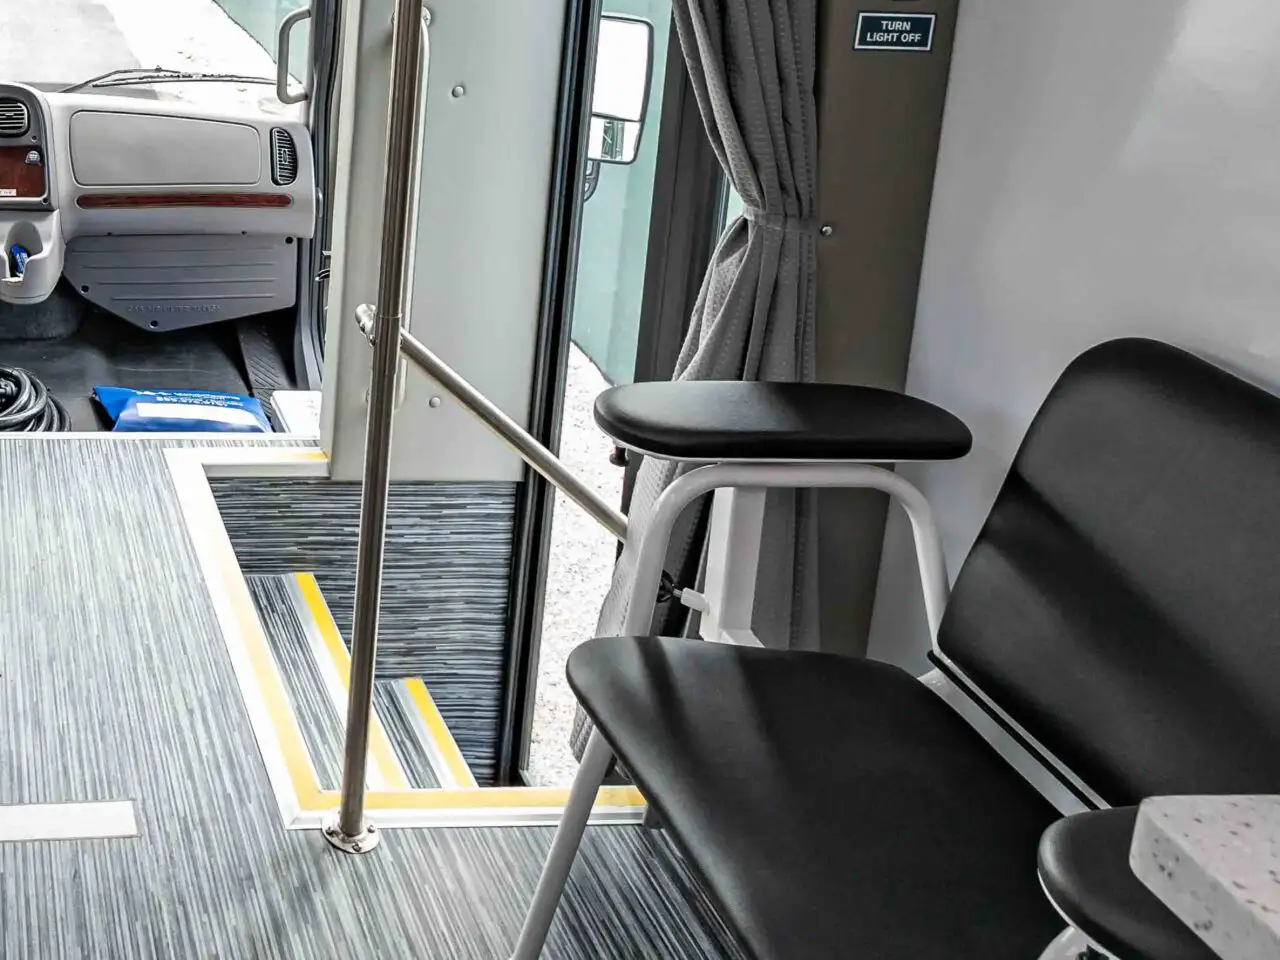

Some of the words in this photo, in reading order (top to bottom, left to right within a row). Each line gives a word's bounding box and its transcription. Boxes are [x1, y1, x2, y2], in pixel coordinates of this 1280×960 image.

[880, 20, 911, 31] TURN
[866, 32, 899, 42] LIGHT
[900, 33, 922, 43] OFF
